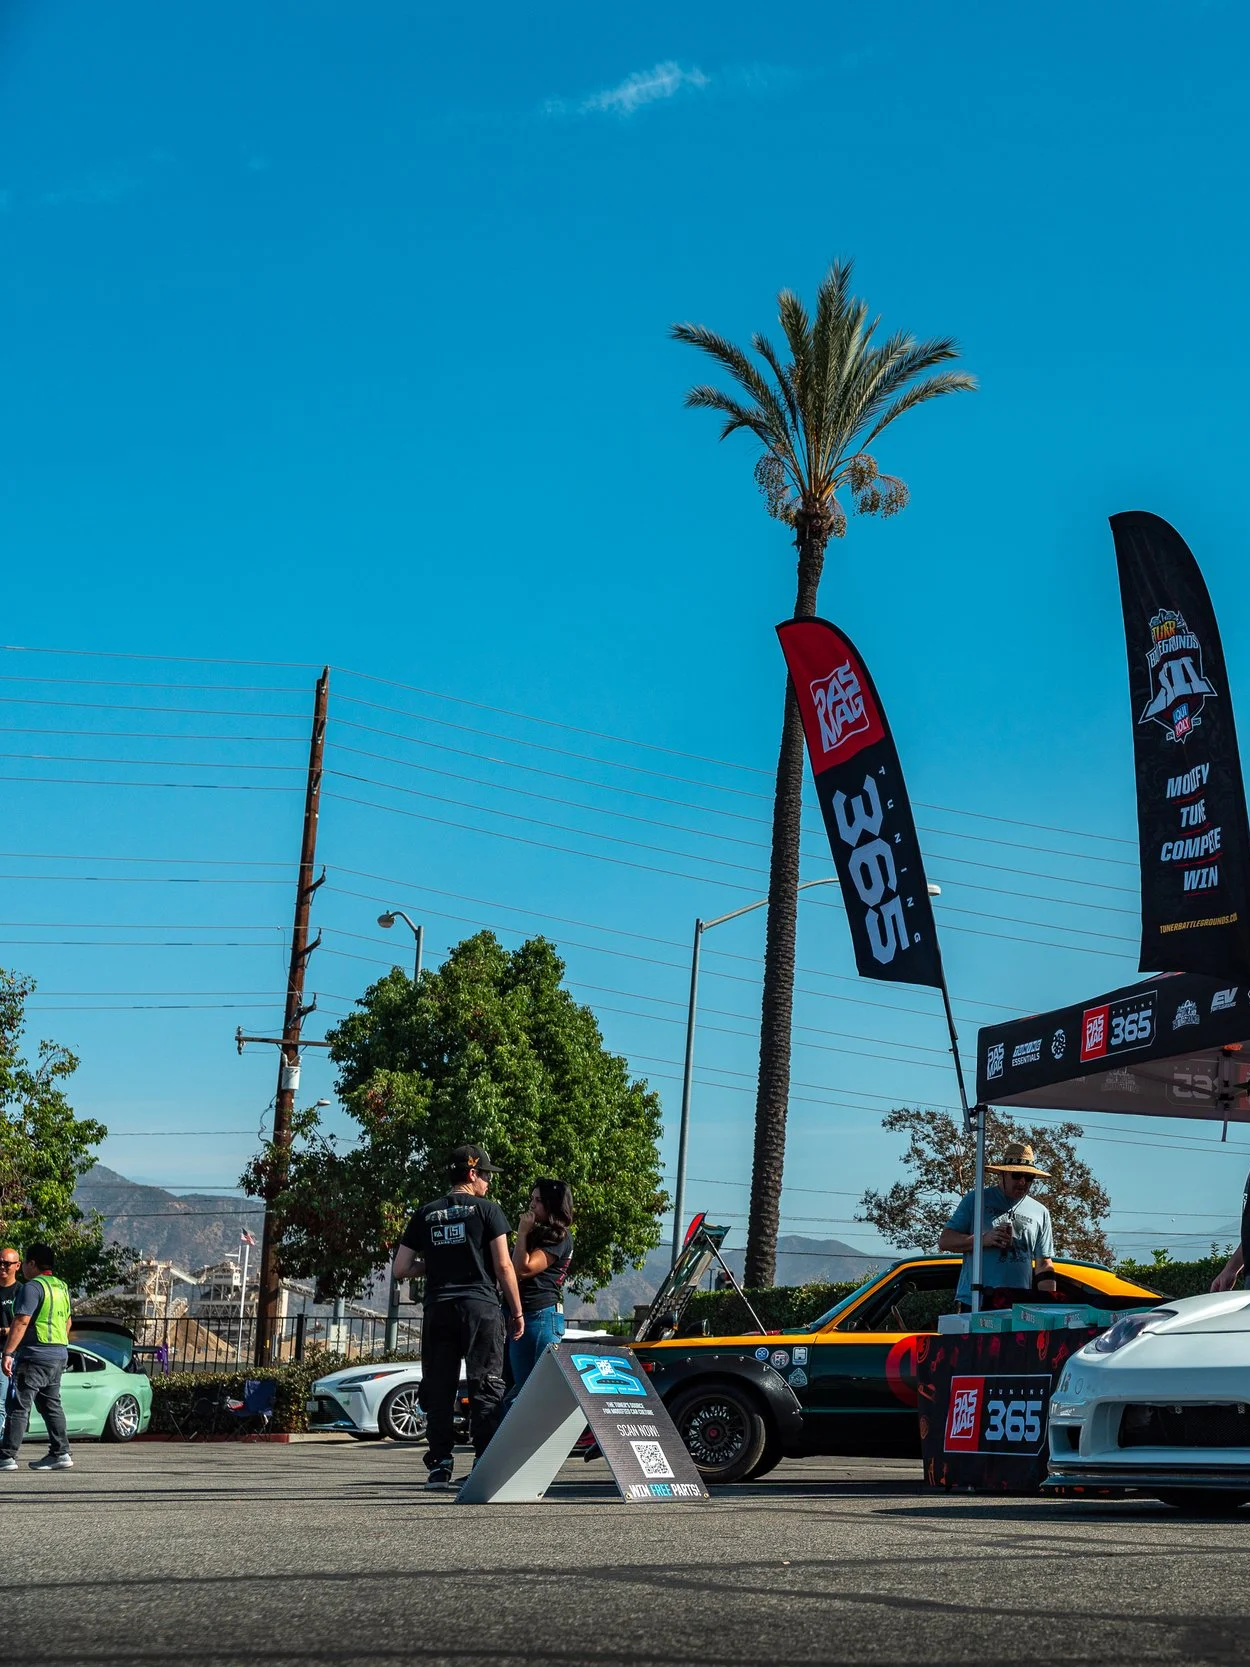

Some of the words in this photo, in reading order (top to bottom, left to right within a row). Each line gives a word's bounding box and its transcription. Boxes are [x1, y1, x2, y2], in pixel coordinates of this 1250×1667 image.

[814, 662, 861, 712] PAS
[817, 694, 865, 753] MAG
[832, 774, 909, 965] 365
[1184, 865, 1218, 891] WIN
[1211, 987, 1238, 1007] EV
[1087, 1013, 1104, 1034] PAS
[1110, 1009, 1152, 1046] 365
[988, 1042, 1005, 1063] PAS
[1086, 1031, 1104, 1052] MAG
[954, 1389, 977, 1413] PAS
[988, 1388, 1044, 1396] TUNING
[616, 1424, 639, 1437] SCAN
[637, 1424, 660, 1437] NOW!
[951, 1408, 975, 1437] MAG
[985, 1400, 1042, 1442] 365
[628, 1484, 651, 1498] WIN
[649, 1483, 673, 1497] FREE
[670, 1483, 702, 1497] PARTS!
